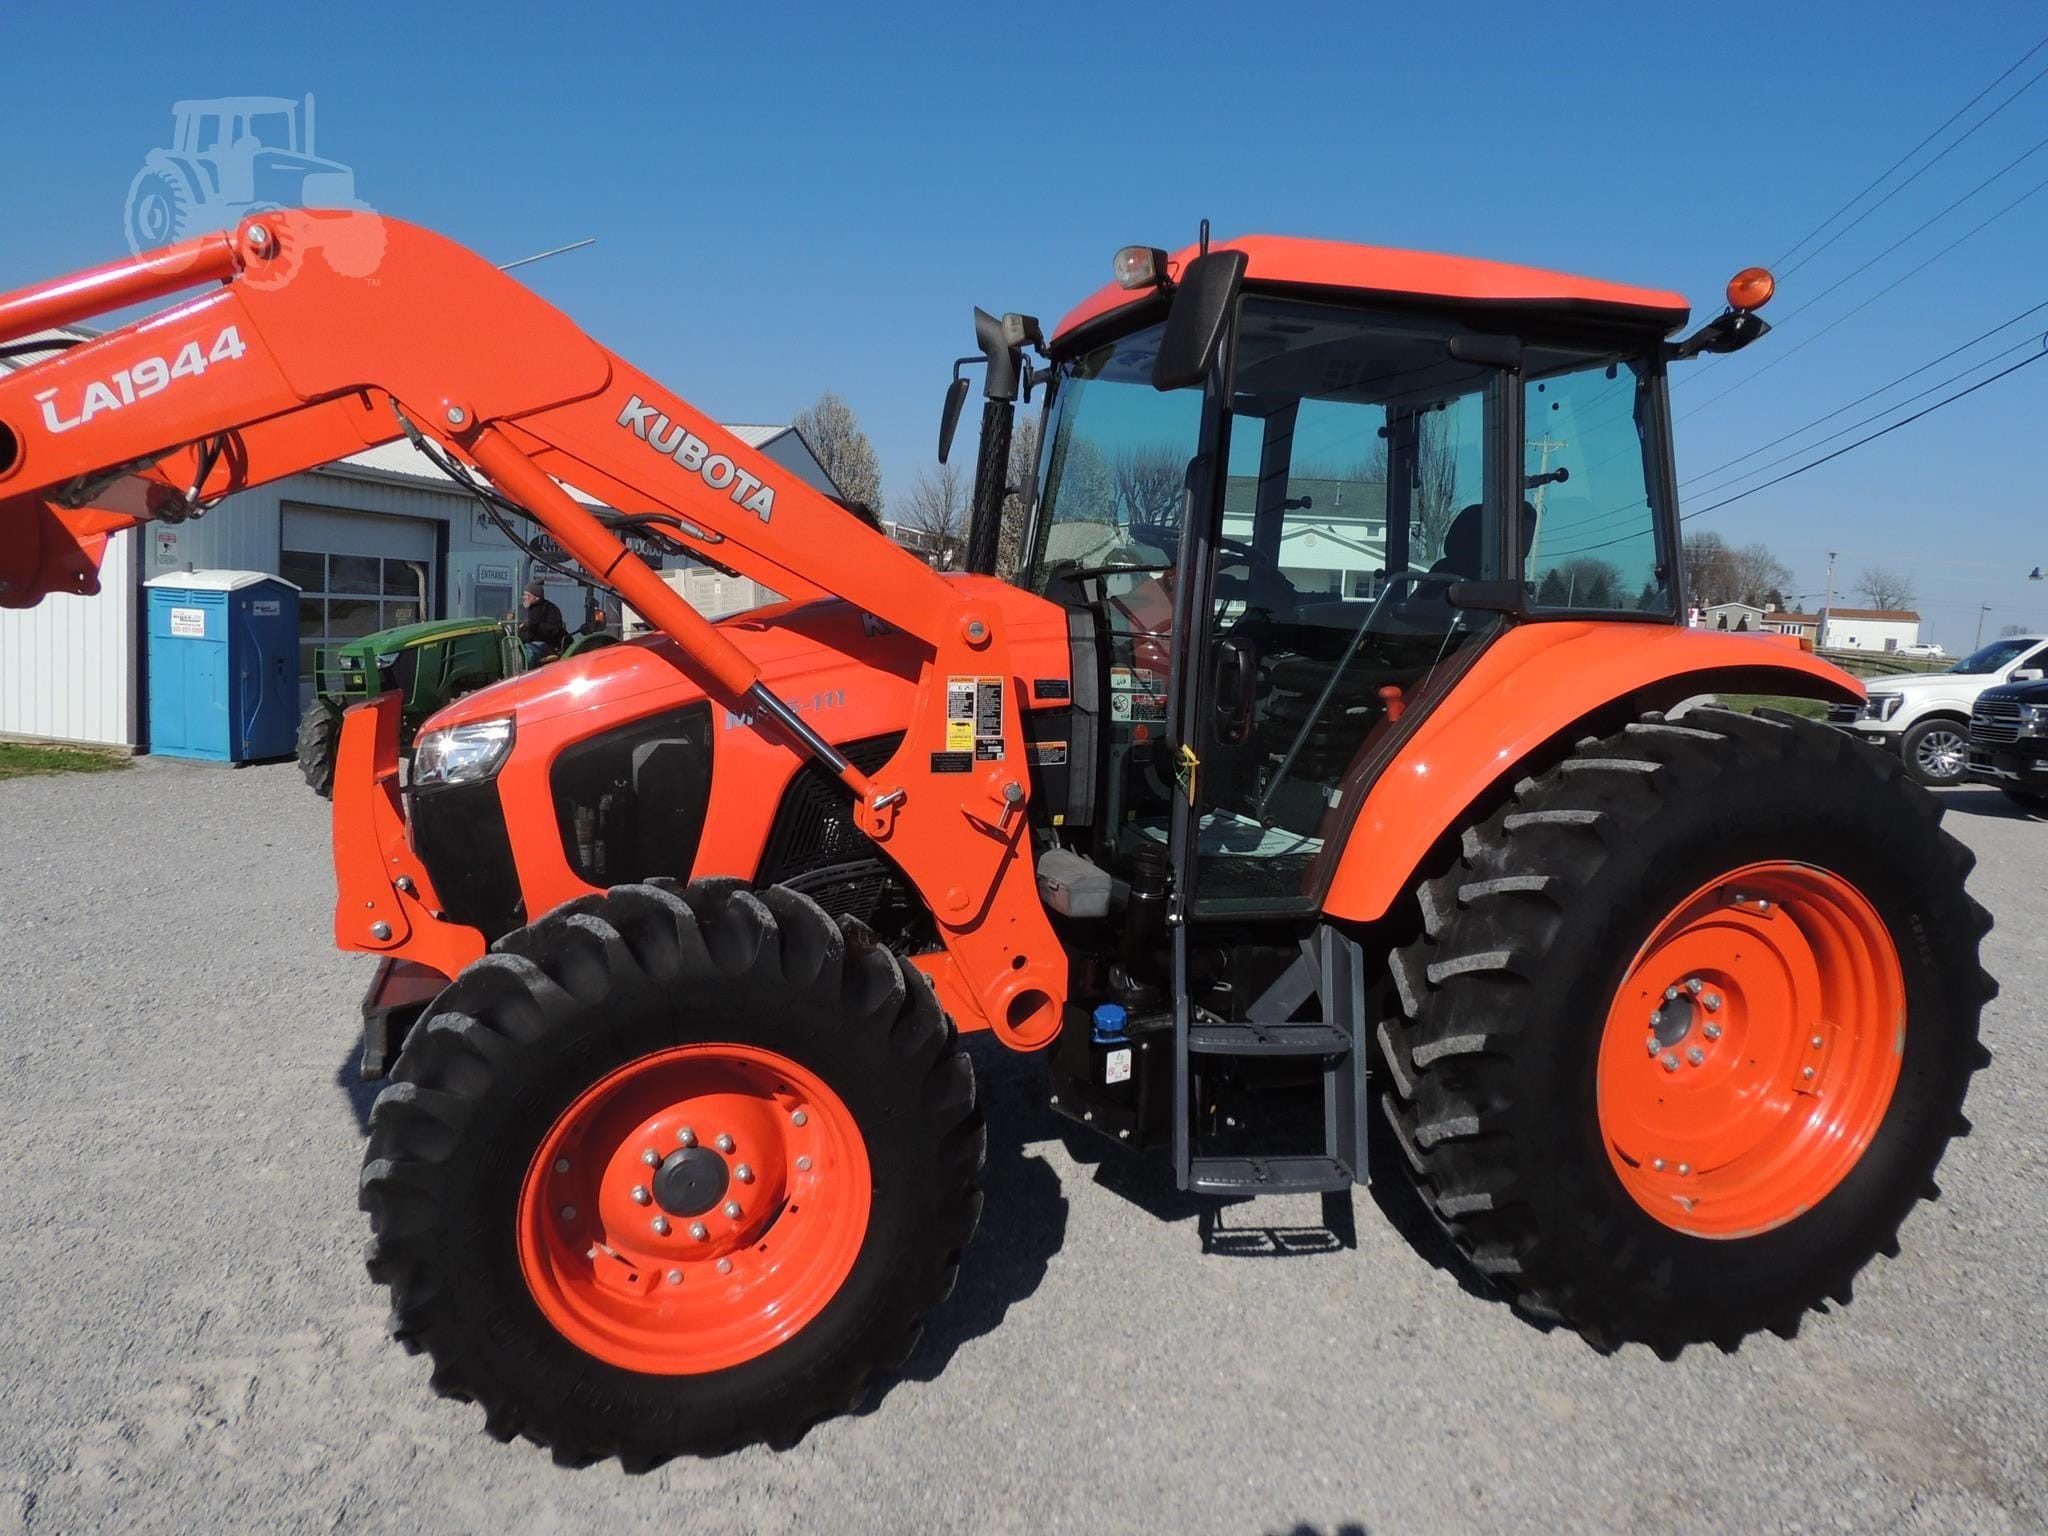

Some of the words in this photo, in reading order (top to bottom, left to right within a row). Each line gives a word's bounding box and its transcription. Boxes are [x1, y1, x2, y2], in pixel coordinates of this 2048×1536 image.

[34, 326, 246, 434] LA1944
[616, 394, 776, 524] KUBOTA
[481, 569, 509, 580] ENTRANCE
